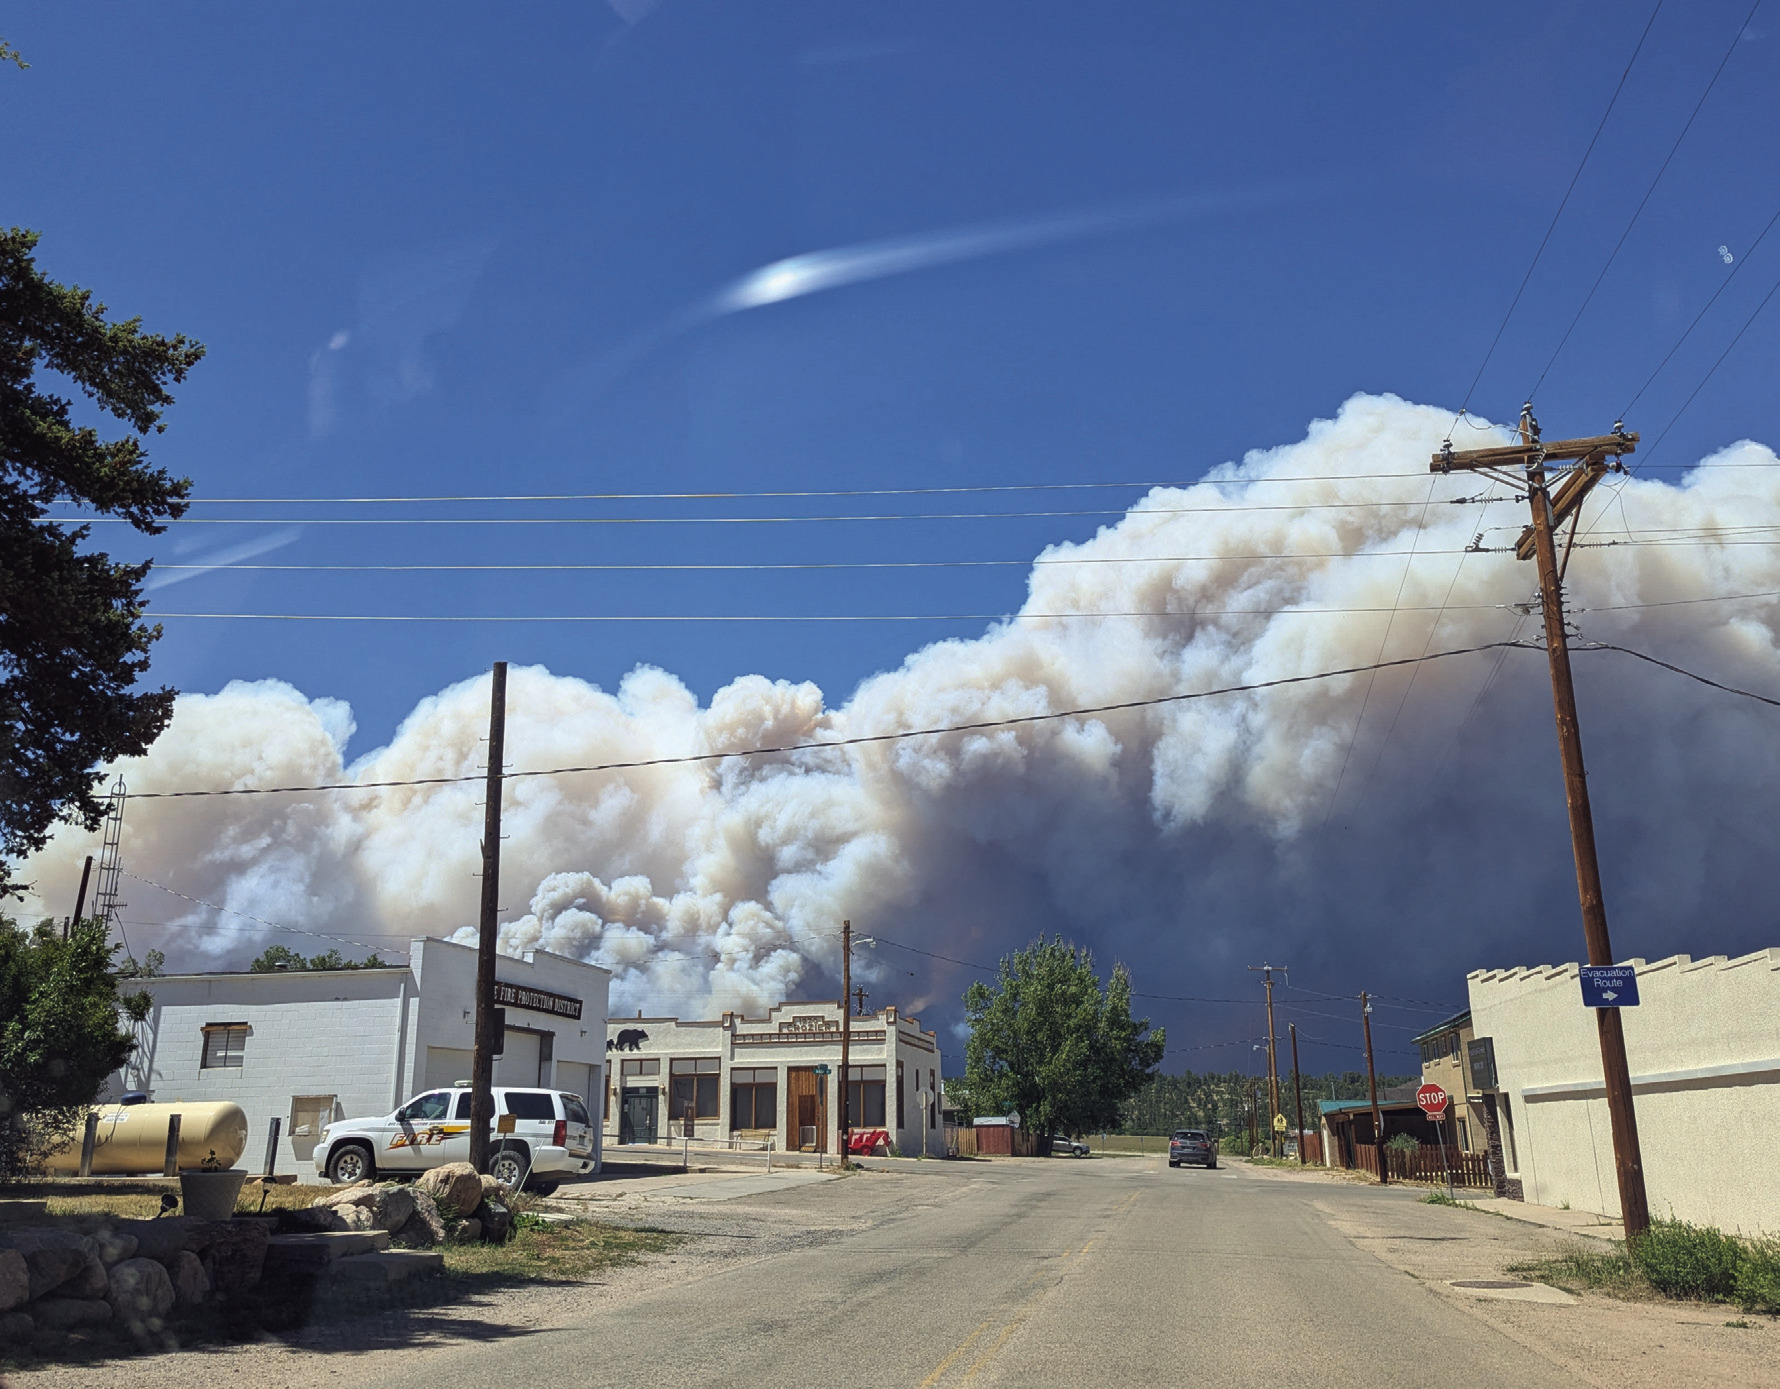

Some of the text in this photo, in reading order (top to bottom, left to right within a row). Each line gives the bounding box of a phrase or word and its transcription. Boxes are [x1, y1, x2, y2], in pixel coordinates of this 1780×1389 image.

[1580, 968, 1634, 978] Evacuation
[1593, 978, 1623, 988] Route
[500, 986, 516, 1003] FIRE
[517, 990, 554, 1010] PROTECTION
[554, 998, 580, 1016] DISTRICT
[786, 1023, 831, 1032] CROZIER
[1419, 1091, 1445, 1105] STOP
[390, 1133, 444, 1145] FIRE
